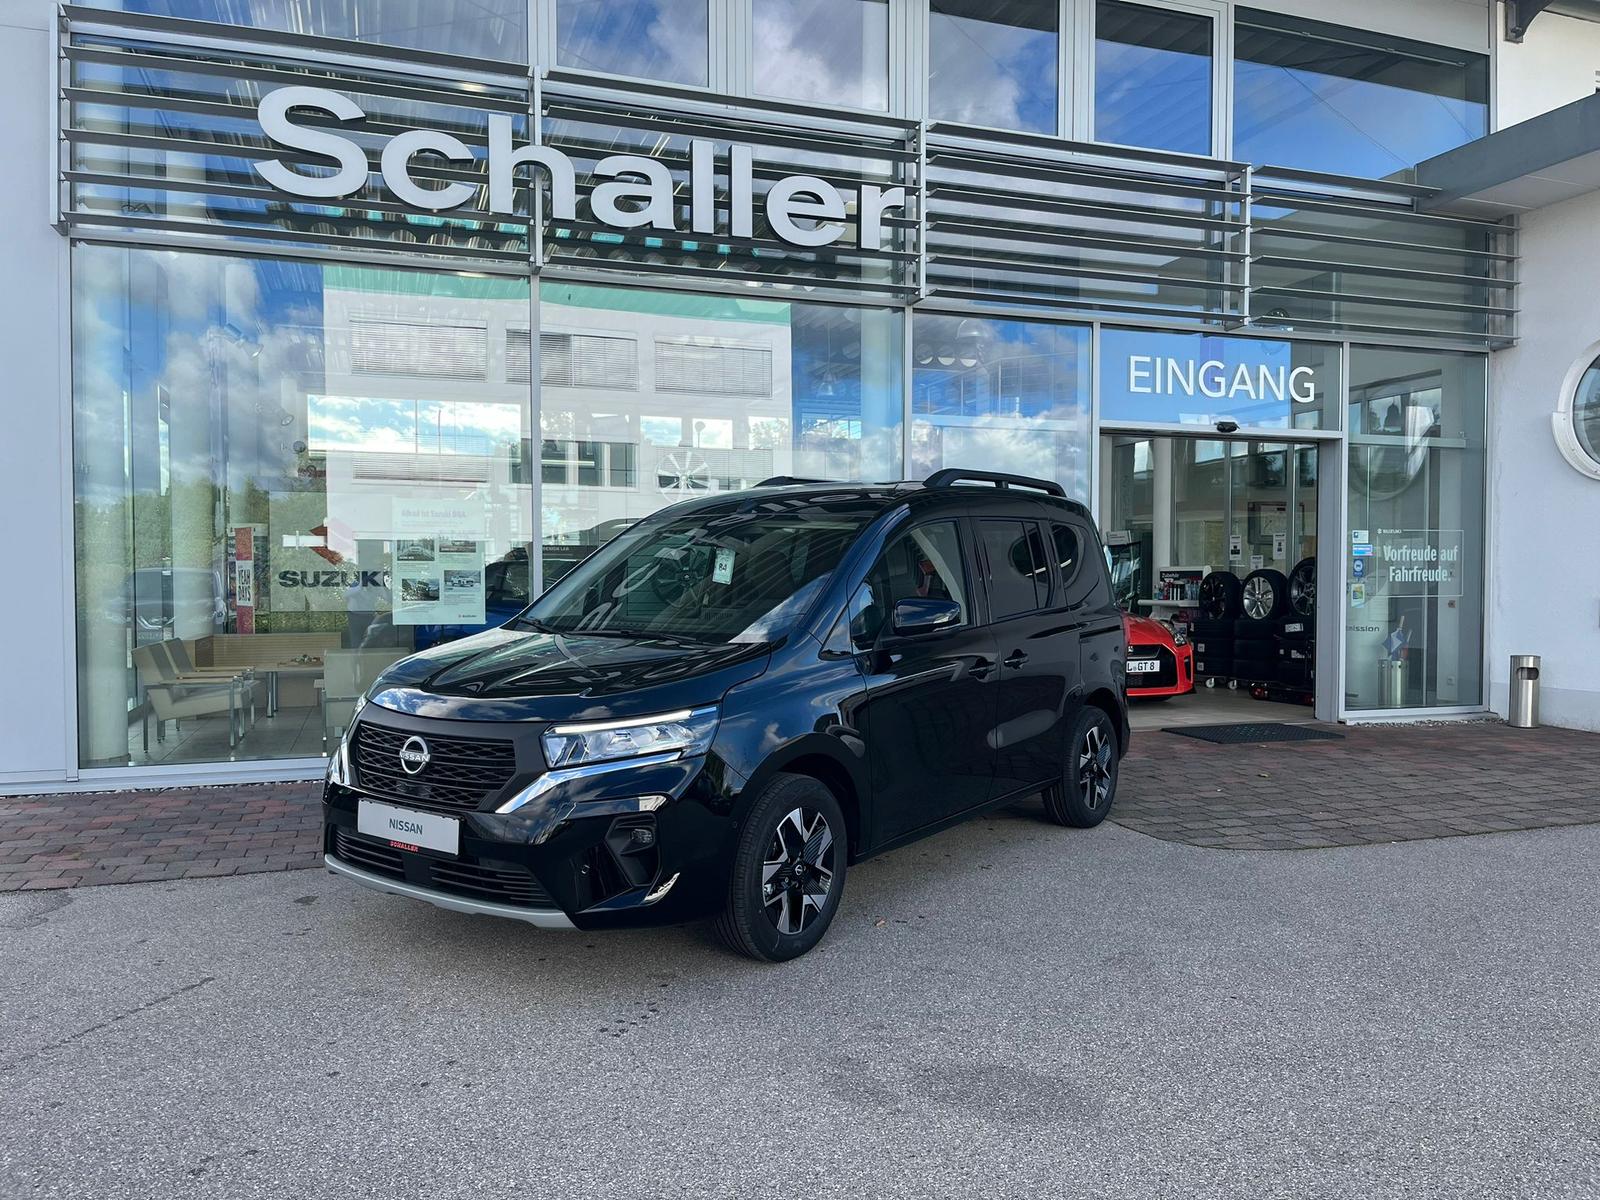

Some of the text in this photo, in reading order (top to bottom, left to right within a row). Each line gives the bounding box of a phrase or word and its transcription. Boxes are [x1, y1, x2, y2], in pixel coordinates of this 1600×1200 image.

[253, 85, 905, 251] Schaller
[1129, 355, 1315, 403] EINGANG
[1383, 545, 1438, 561] Vorfreude
[1440, 545, 1458, 561] auf
[1389, 566, 1452, 582] Fahrfreude.
[389, 818, 423, 836] NISSAN
[389, 841, 419, 852] SCHALLER
